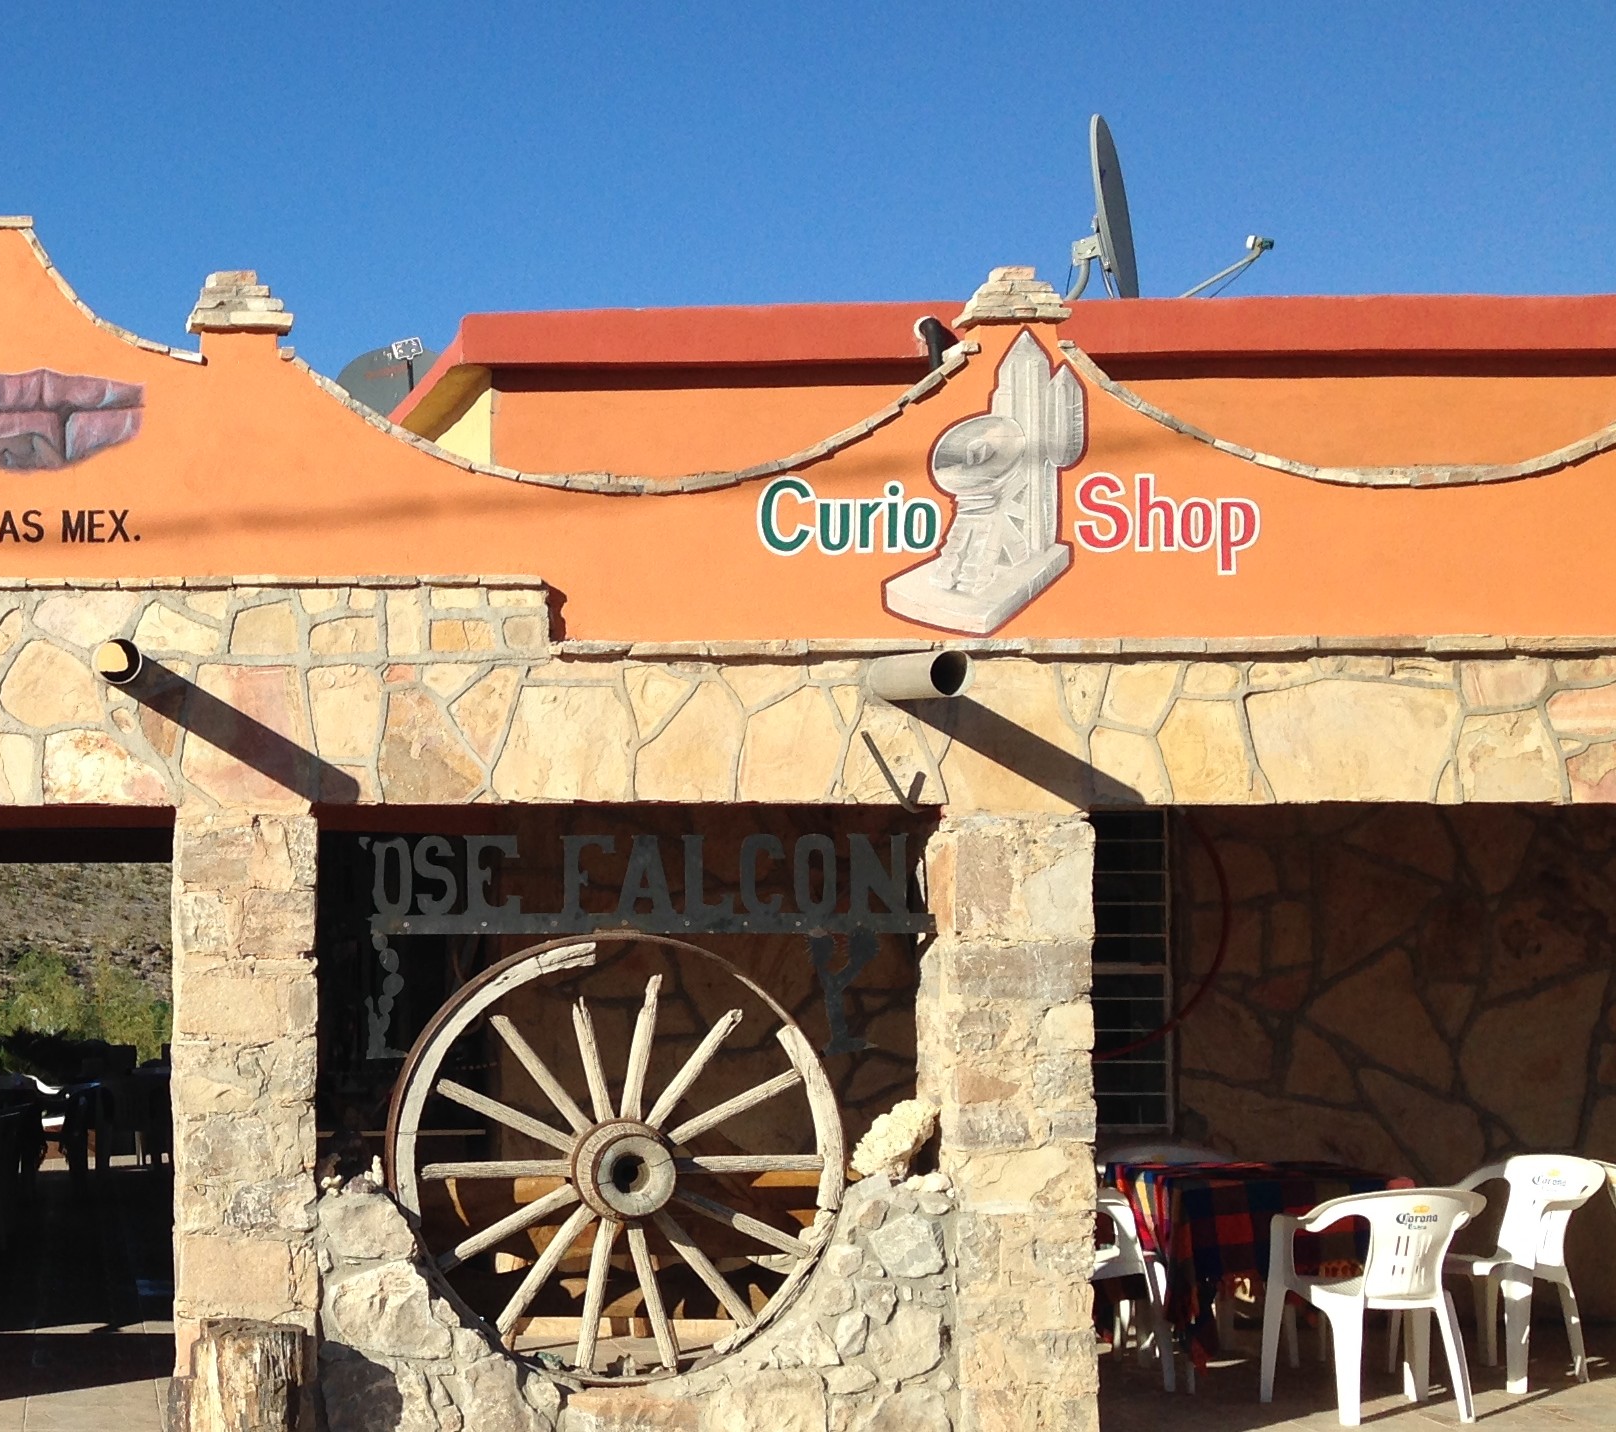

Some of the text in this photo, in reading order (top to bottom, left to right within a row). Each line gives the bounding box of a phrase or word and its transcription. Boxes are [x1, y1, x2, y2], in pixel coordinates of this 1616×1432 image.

[61, 509, 142, 544] MEX.
[757, 471, 1260, 575] Curio Shop
[360, 832, 910, 916] OSE FALCON
[1395, 1212, 1438, 1226] Corona
